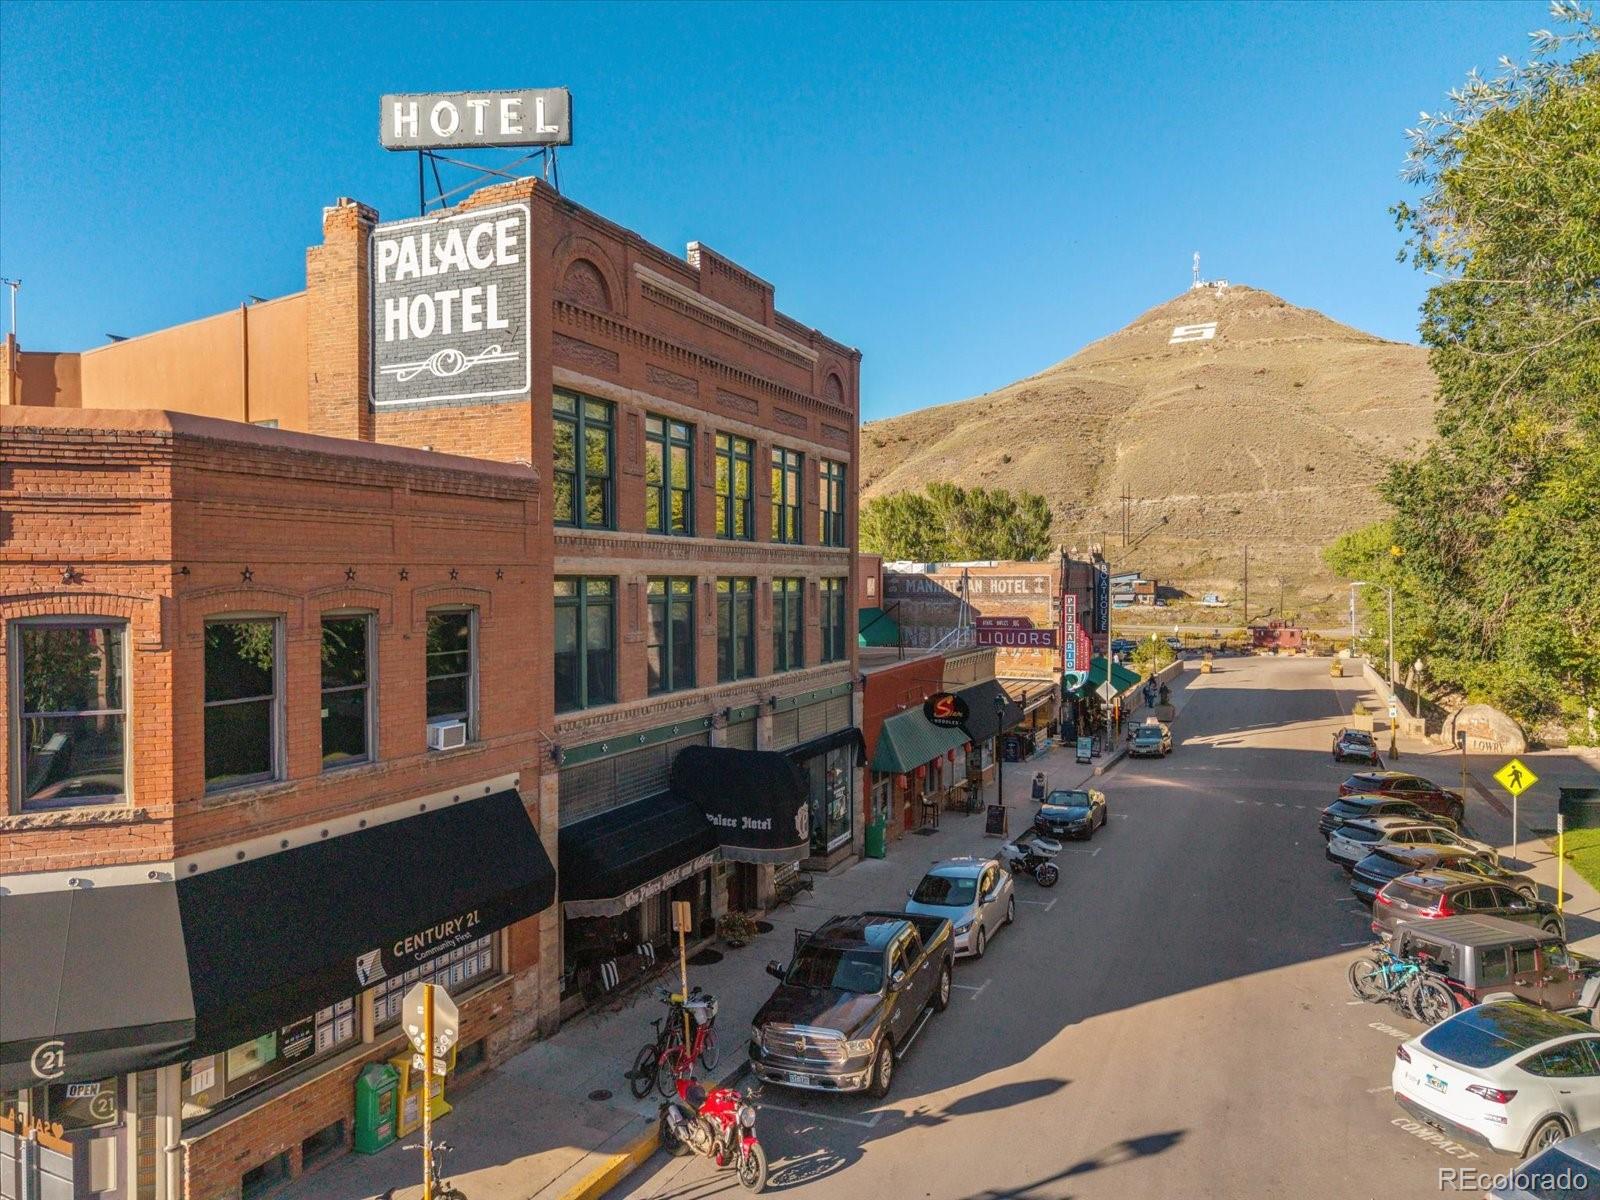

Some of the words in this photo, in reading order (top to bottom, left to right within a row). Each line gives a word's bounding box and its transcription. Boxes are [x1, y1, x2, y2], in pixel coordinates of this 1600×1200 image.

[394, 96, 559, 138] HOTEL
[378, 217, 520, 283] PALACE
[384, 284, 509, 342] HOTEL
[905, 579, 983, 593] MANHATAN
[990, 579, 1030, 594] HOTEL
[1099, 564, 1108, 631] BOATHOUSE
[979, 632, 1051, 646] LIQUORS
[705, 812, 738, 828] Palace
[741, 816, 772, 831] Hotel
[393, 915, 463, 957] CENTURY
[466, 909, 481, 928] 21
[414, 938, 456, 961] Community
[455, 931, 473, 944] First
[1368, 1022, 1411, 1041] COMP
[69, 1084, 98, 1097] OPEN
[1391, 1118, 1480, 1160] COMPACT
